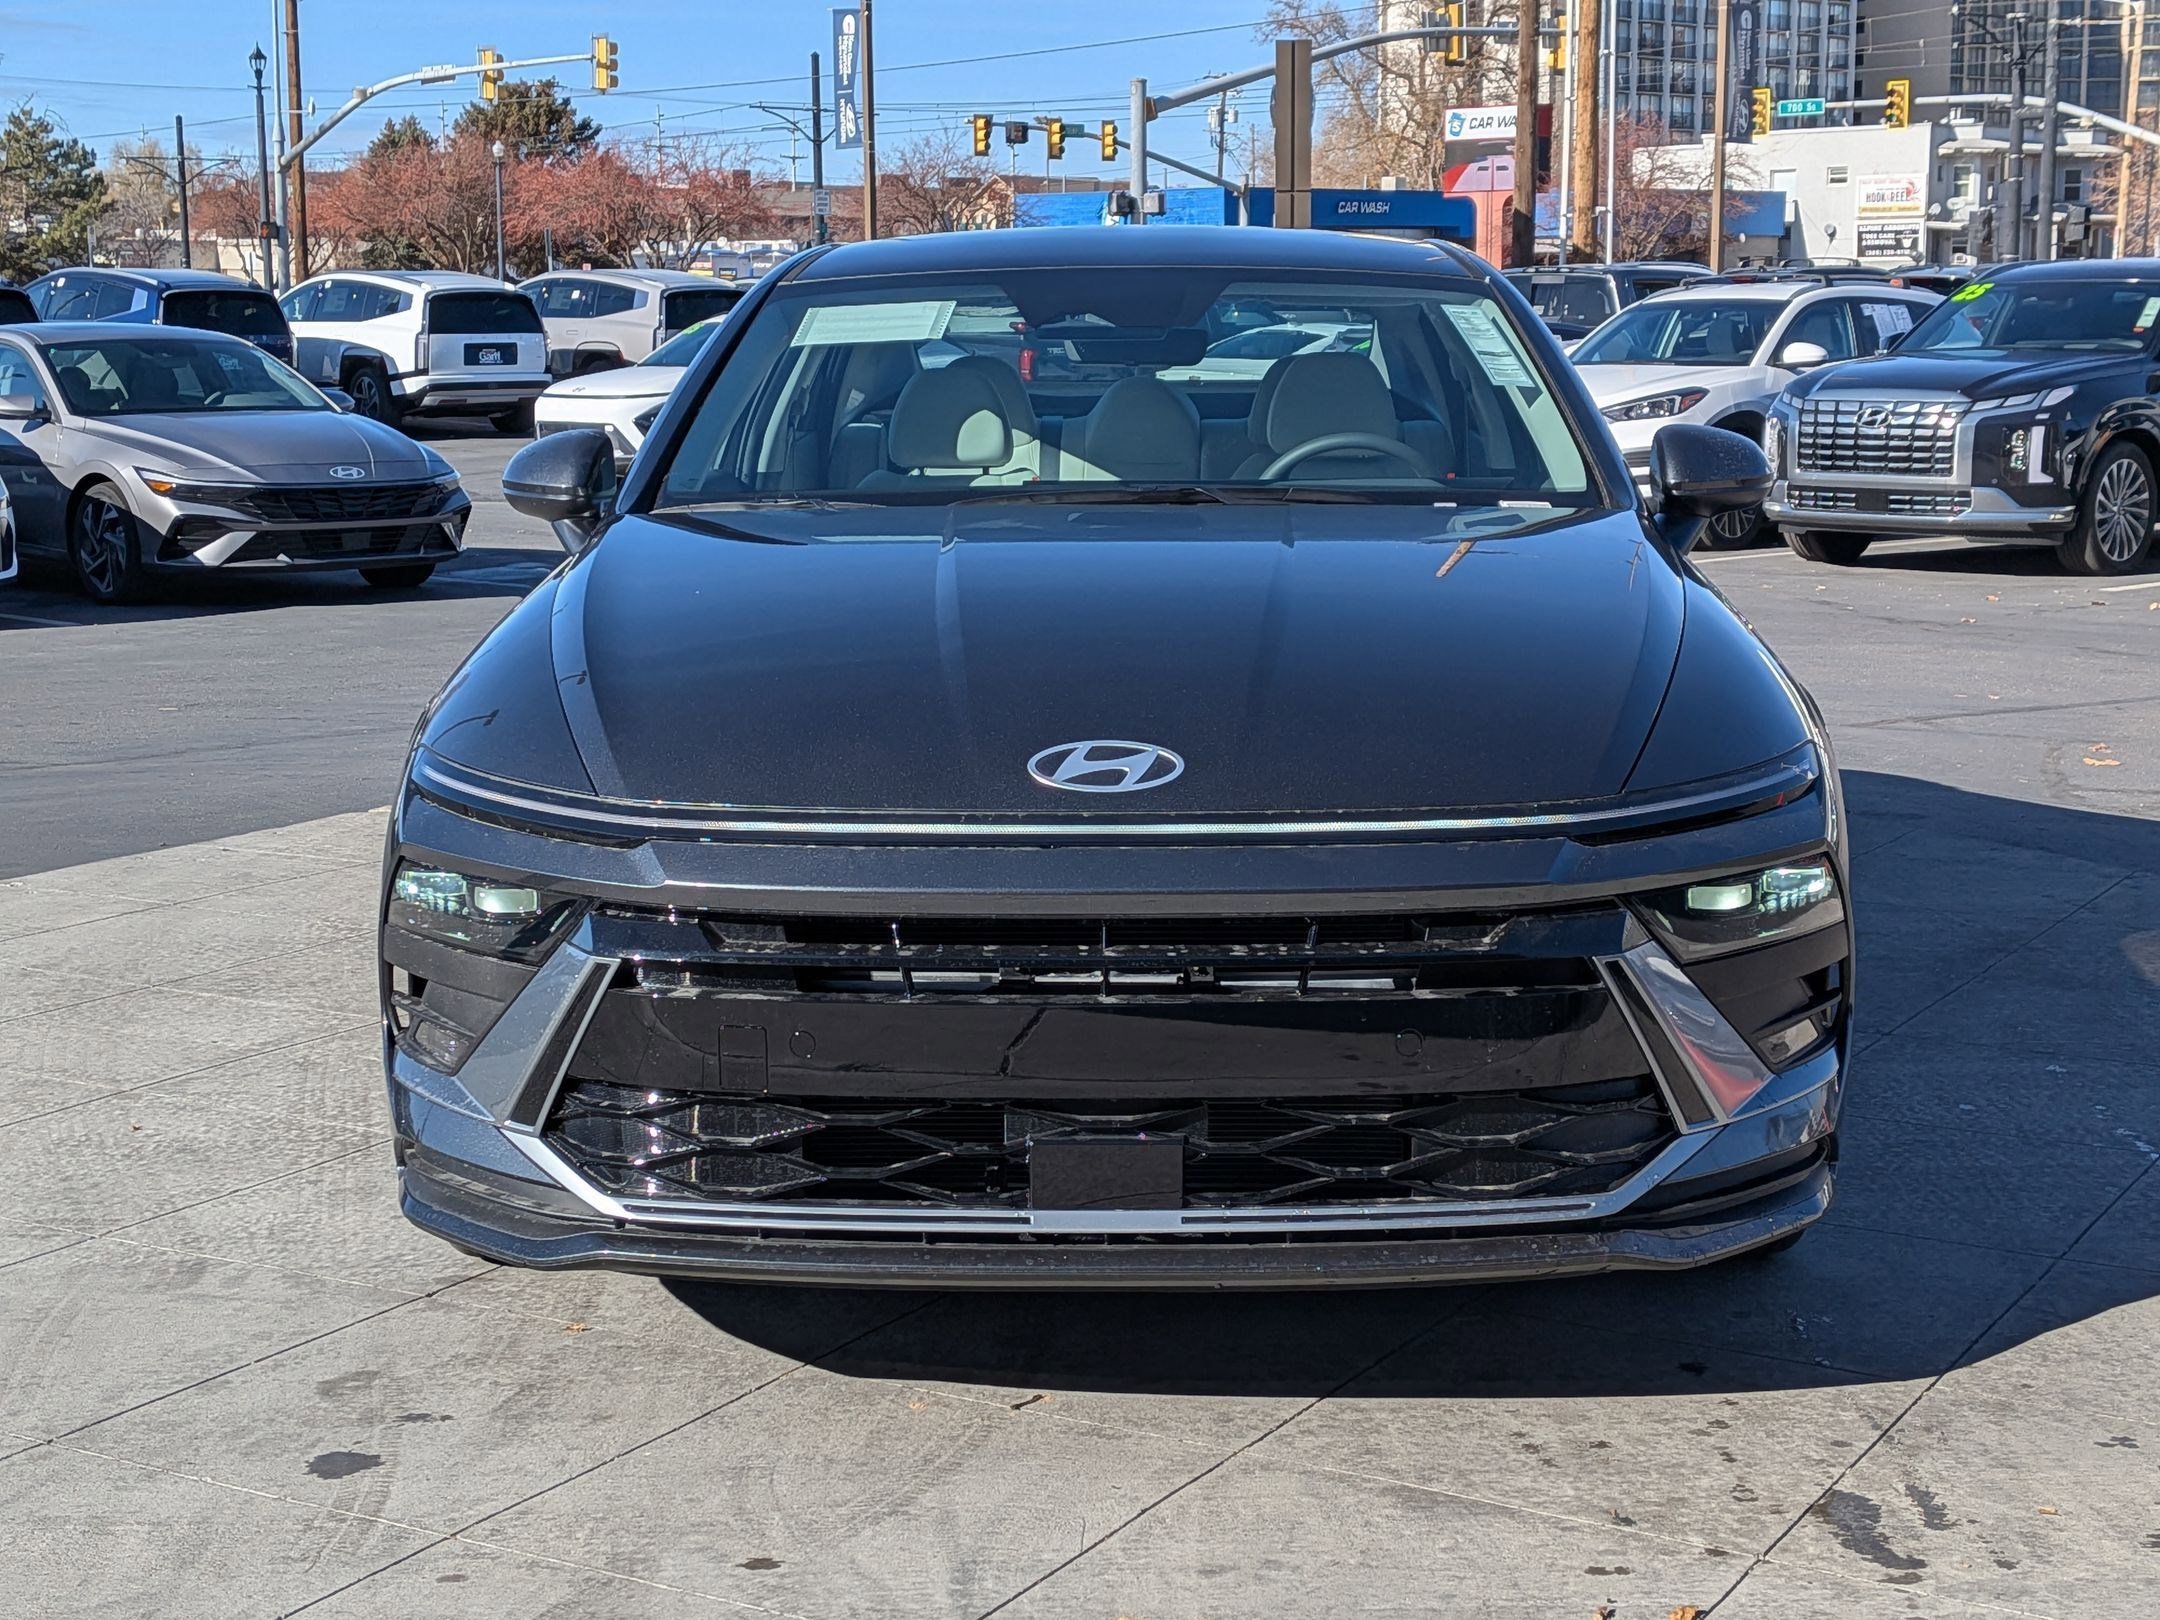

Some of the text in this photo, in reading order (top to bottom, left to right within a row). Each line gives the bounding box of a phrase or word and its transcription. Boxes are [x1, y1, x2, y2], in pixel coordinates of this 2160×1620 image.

[1787, 102, 1803, 113] 700
[1469, 115, 1517, 130] CAR WA
[1337, 201, 1390, 214] CAR WASH
[1951, 283, 1995, 301] 25
